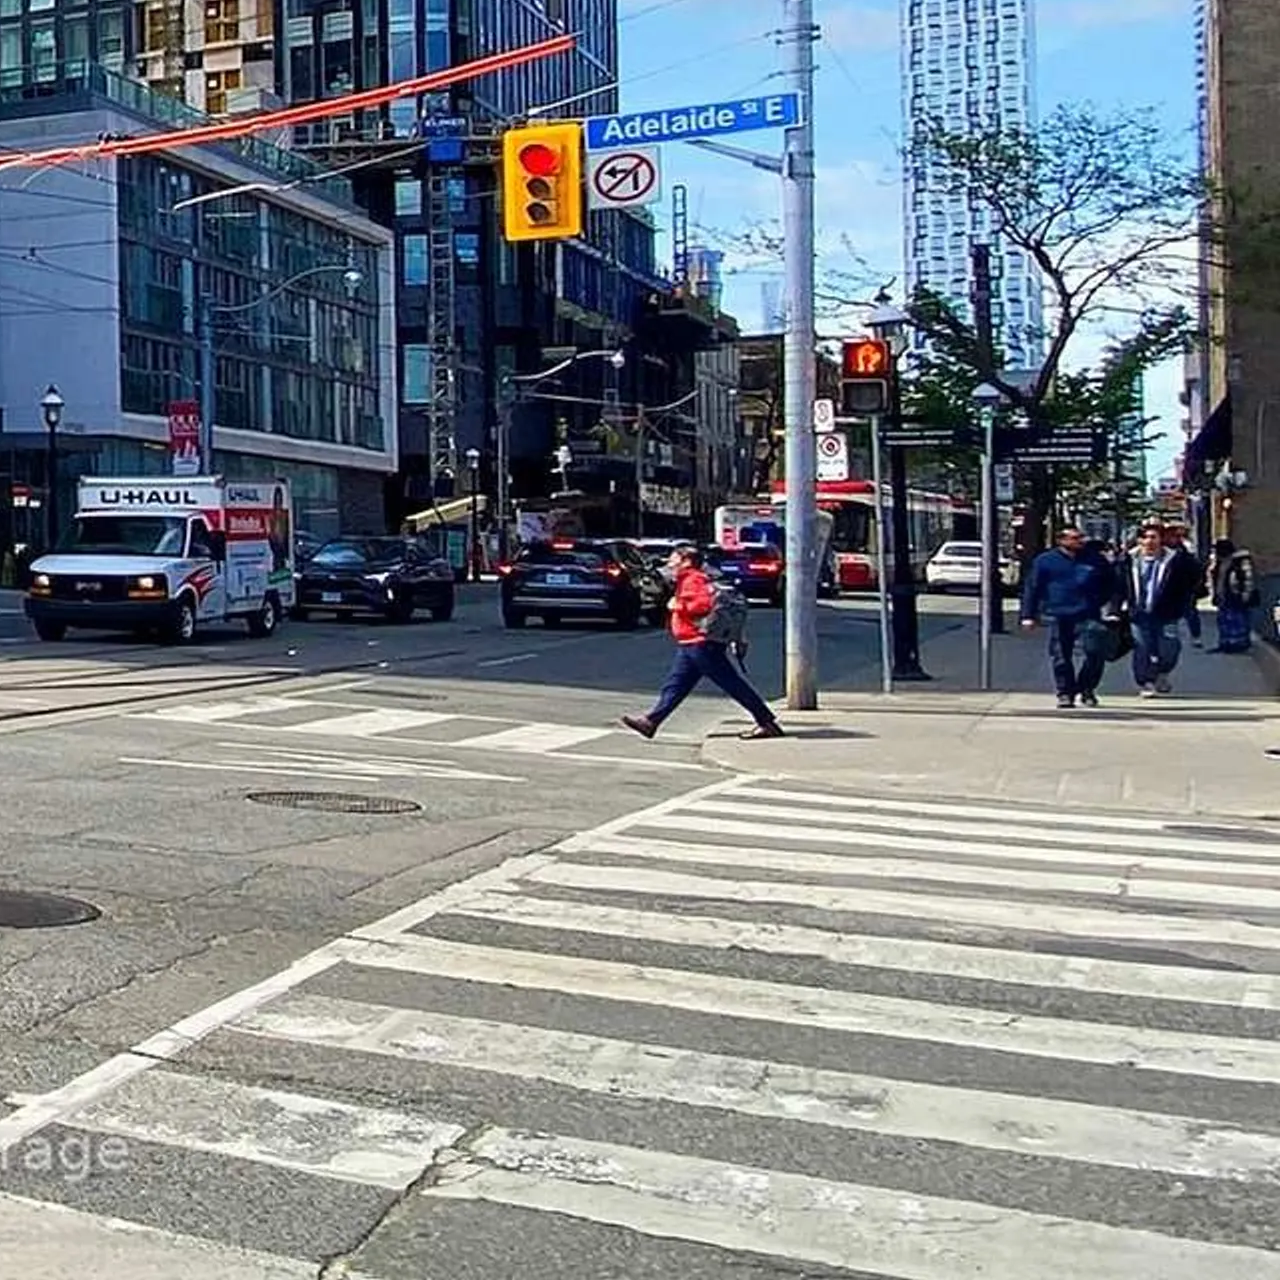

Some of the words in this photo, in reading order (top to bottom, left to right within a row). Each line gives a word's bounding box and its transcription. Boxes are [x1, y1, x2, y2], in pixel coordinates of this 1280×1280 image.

[602, 106, 736, 141] Adelaide
[764, 96, 785, 122] E
[100, 490, 198, 505] U-HAUL
